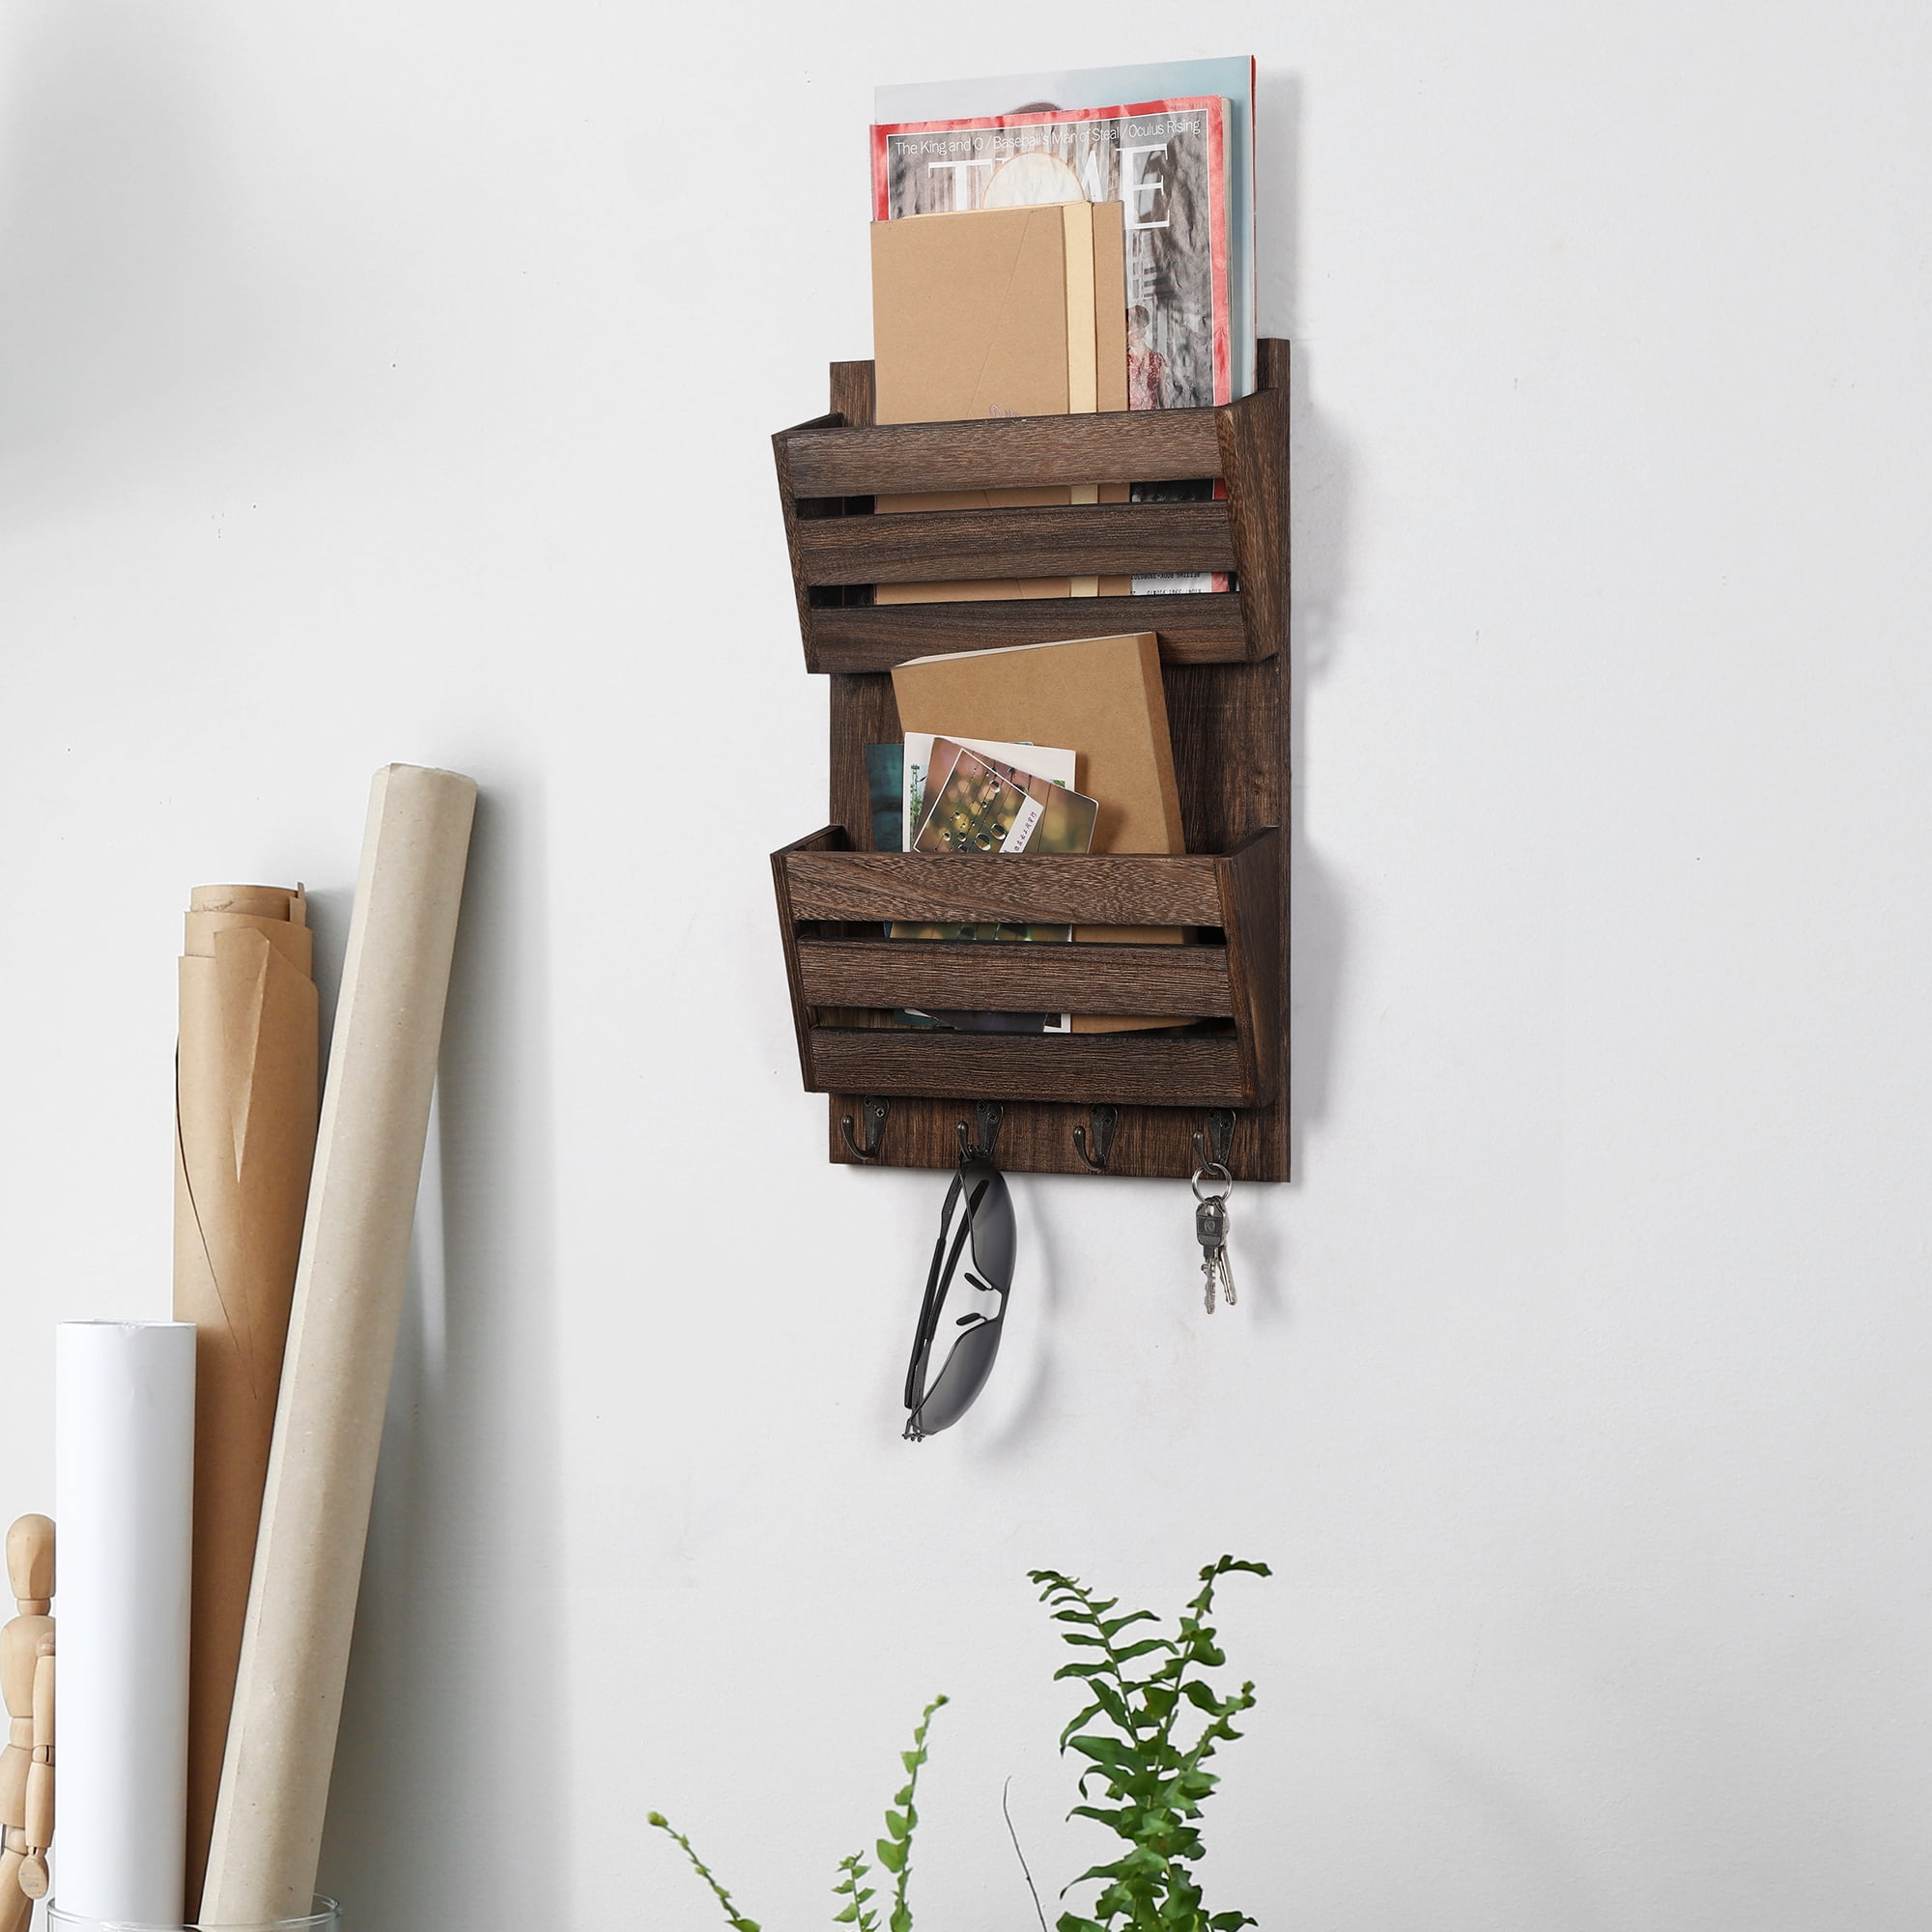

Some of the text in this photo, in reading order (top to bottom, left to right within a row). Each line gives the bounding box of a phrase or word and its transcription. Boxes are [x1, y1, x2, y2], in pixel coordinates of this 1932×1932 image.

[895, 142, 918, 155] The
[920, 140, 947, 156] King
[949, 138, 972, 152] and
[993, 134, 1049, 149] Baseball's
[1052, 132, 1078, 145] Man
[1080, 128, 1091, 141] of
[1092, 127, 1120, 141] Steal
[1128, 123, 1164, 138] Oculus
[1166, 119, 1201, 134] Rising
[928, 143, 1170, 230] TE
